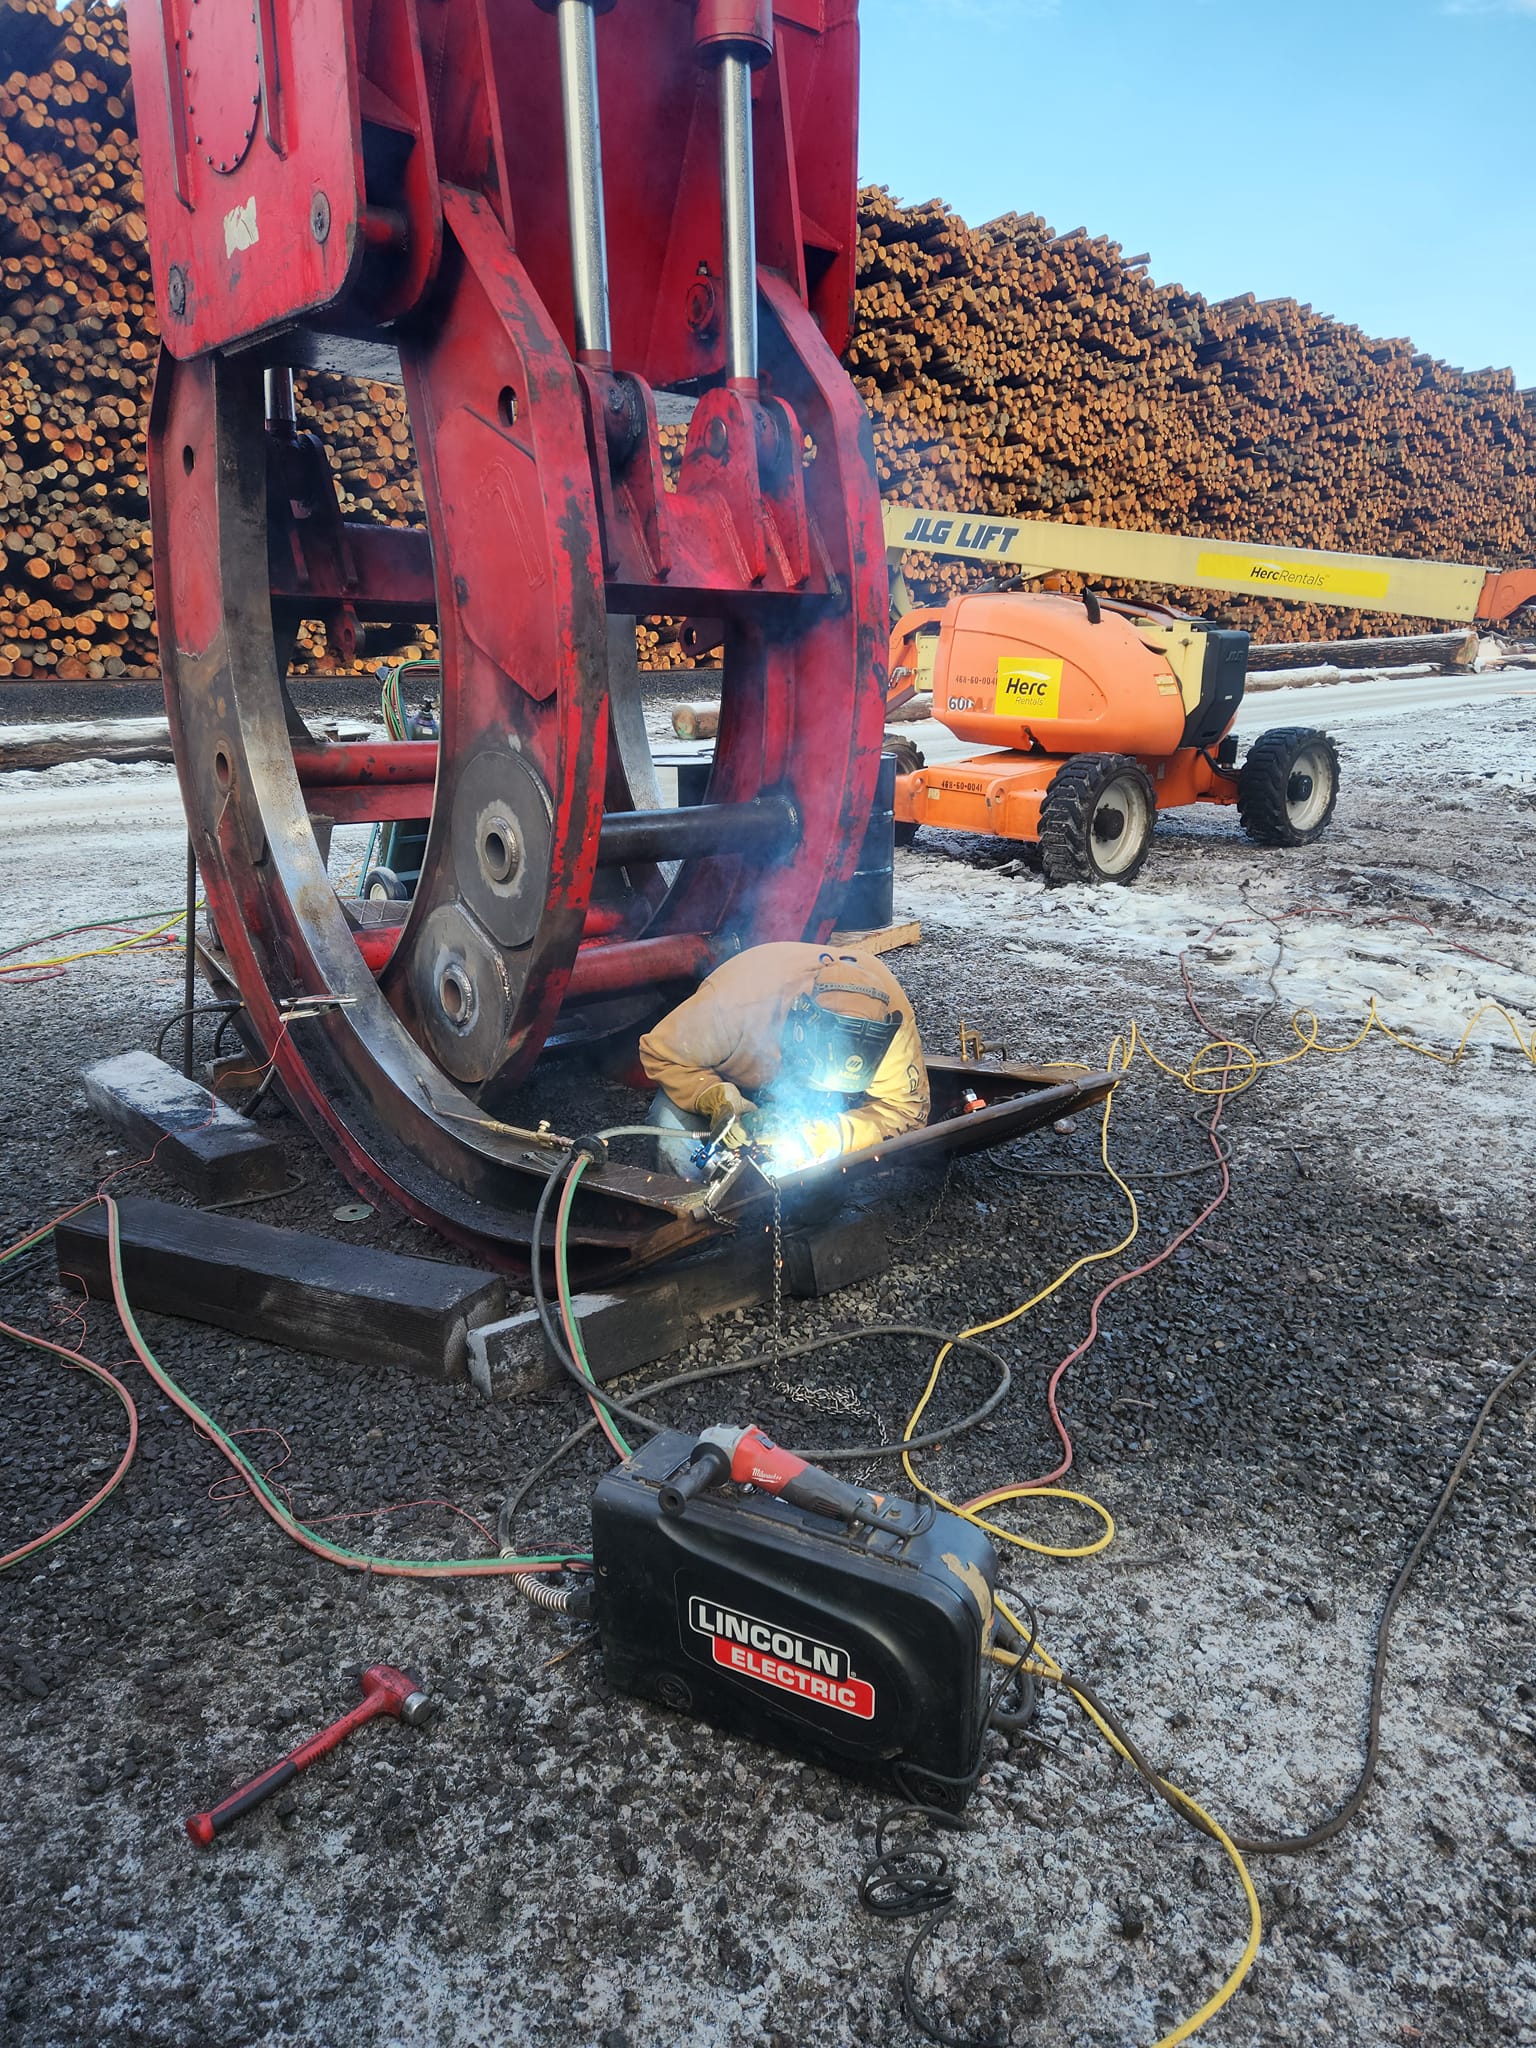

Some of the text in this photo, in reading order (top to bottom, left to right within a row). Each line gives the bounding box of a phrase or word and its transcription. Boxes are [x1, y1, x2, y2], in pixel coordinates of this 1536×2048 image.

[904, 517, 1020, 553] JLG LIFT
[1005, 677, 1048, 696] Herc
[1015, 696, 1044, 706] Rentals
[699, 1604, 838, 1677] LINCOLN
[731, 1646, 856, 1708] ELECTRIC
